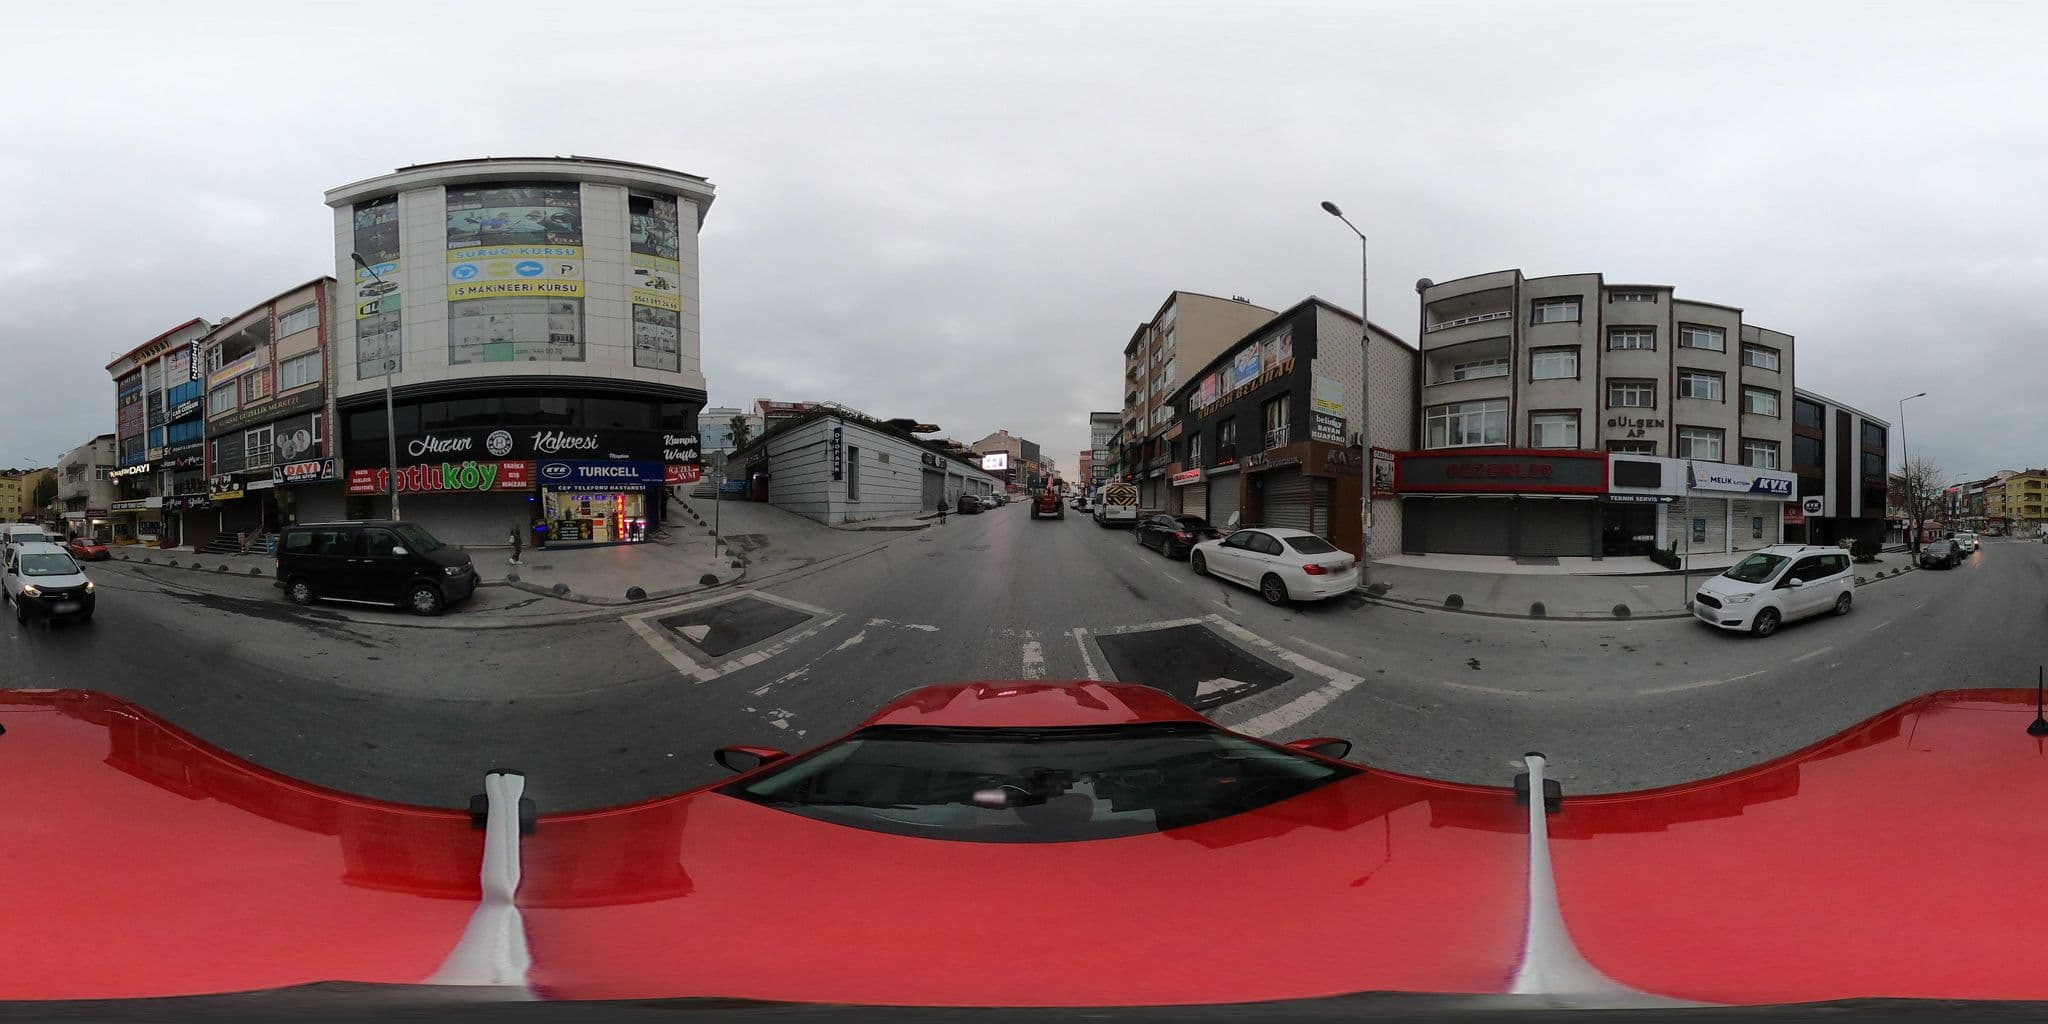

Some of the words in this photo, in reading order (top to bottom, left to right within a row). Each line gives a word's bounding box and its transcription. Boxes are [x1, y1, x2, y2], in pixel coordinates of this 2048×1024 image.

[520, 248, 576, 257] KURSU
[538, 284, 577, 293] KURSU
[1317, 425, 1341, 435] BAYAN
[531, 431, 599, 454] Kahvesi
[663, 434, 698, 446] Kumpir
[663, 448, 698, 462] Waffle
[129, 463, 150, 475] DAYI
[287, 463, 319, 475] DAYI
[578, 466, 640, 477] TURKCELL
[1710, 475, 1732, 484] MELİK
[1759, 478, 1789, 491] KVK
